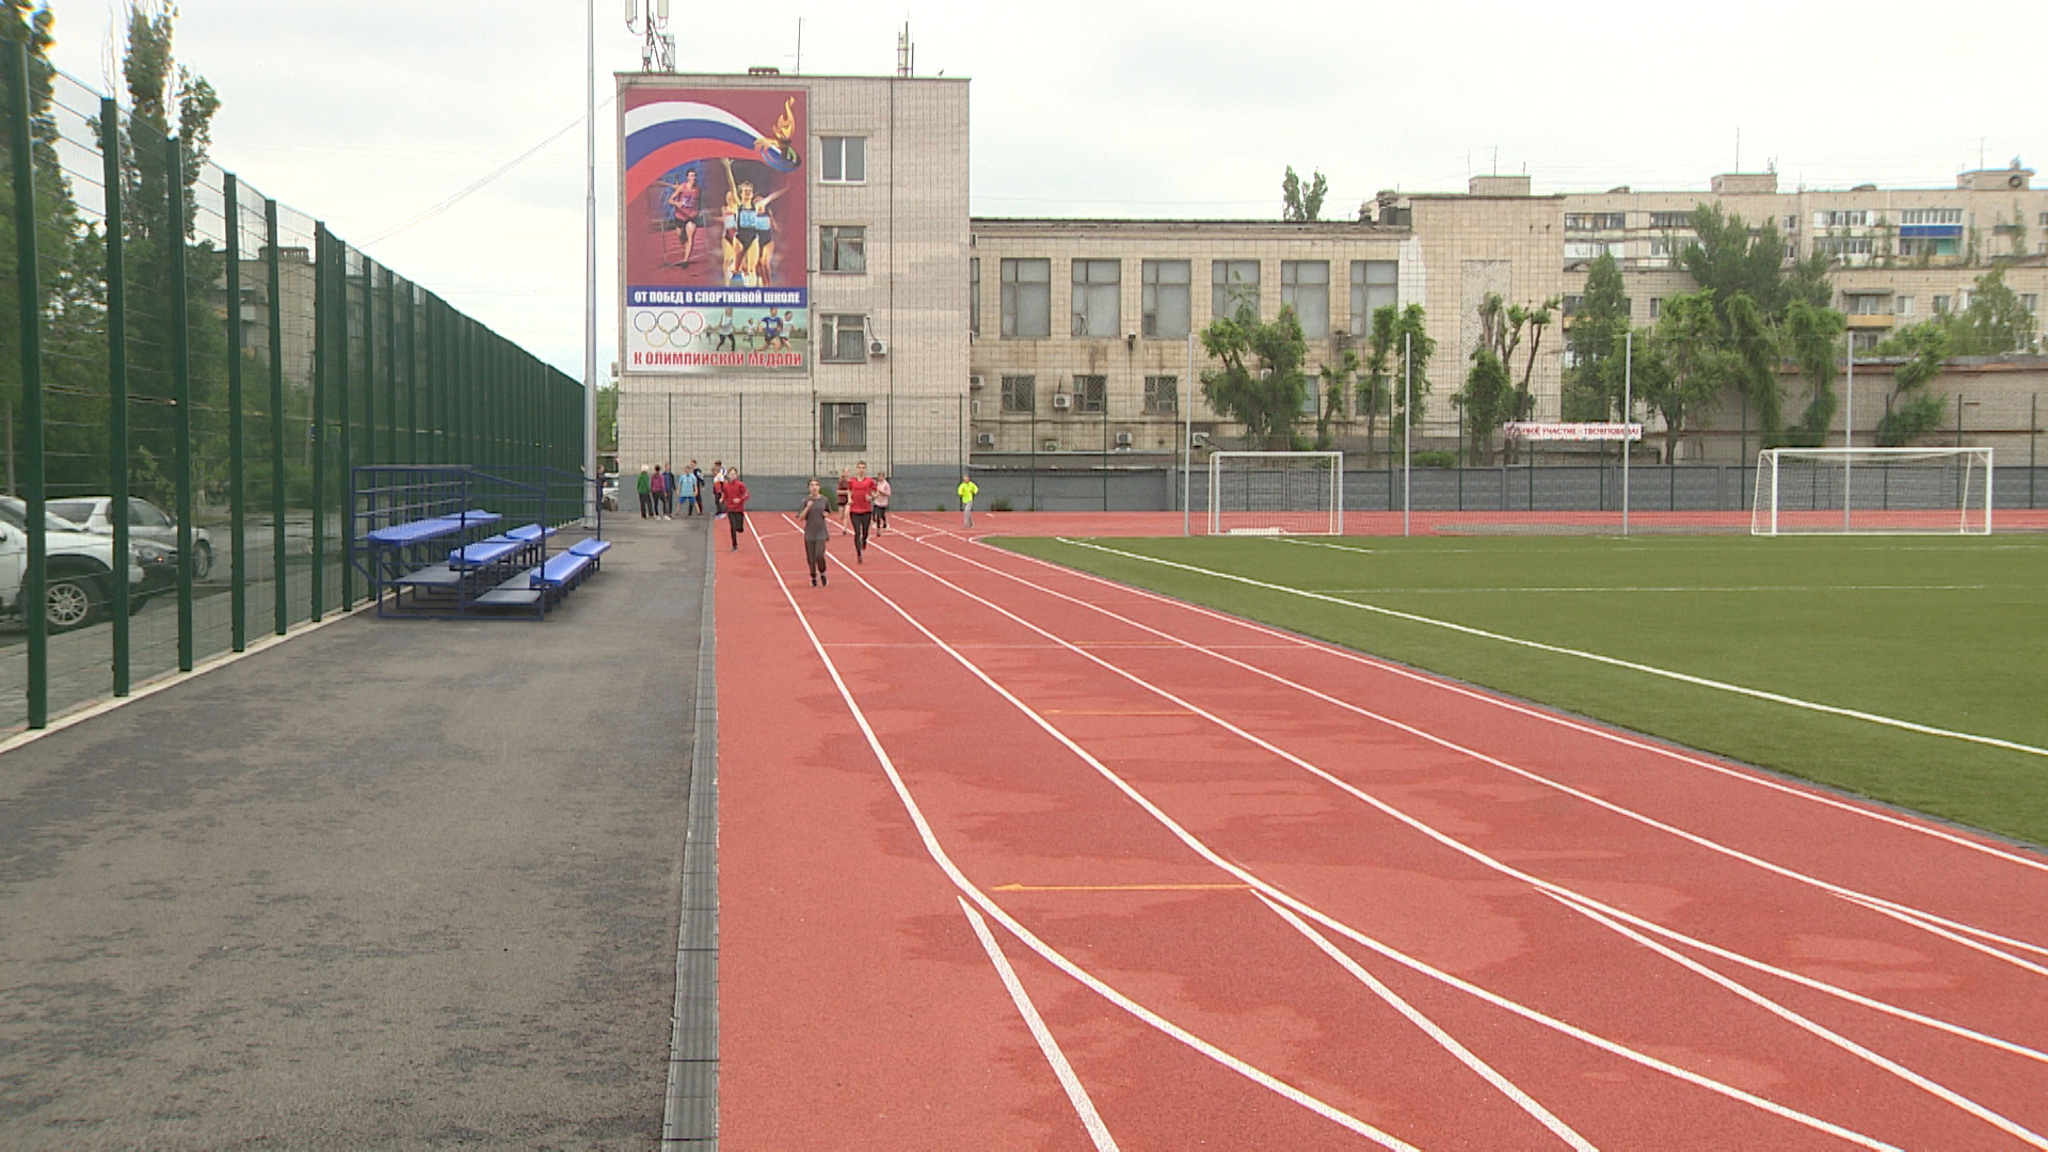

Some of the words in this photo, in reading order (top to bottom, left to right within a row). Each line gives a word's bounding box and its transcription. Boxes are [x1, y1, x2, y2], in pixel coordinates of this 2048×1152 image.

[634, 291, 648, 303] ОТ
[649, 291, 684, 305] ПОБЕД
[685, 292, 693, 303] В
[695, 290, 762, 304] СПОРТИВНОЙ
[763, 291, 801, 304] ШКОЛЕ
[634, 352, 642, 365] К
[645, 350, 744, 366] ОЛИМПИЙСКОЙ
[748, 351, 802, 367] МЕДАЛИ
